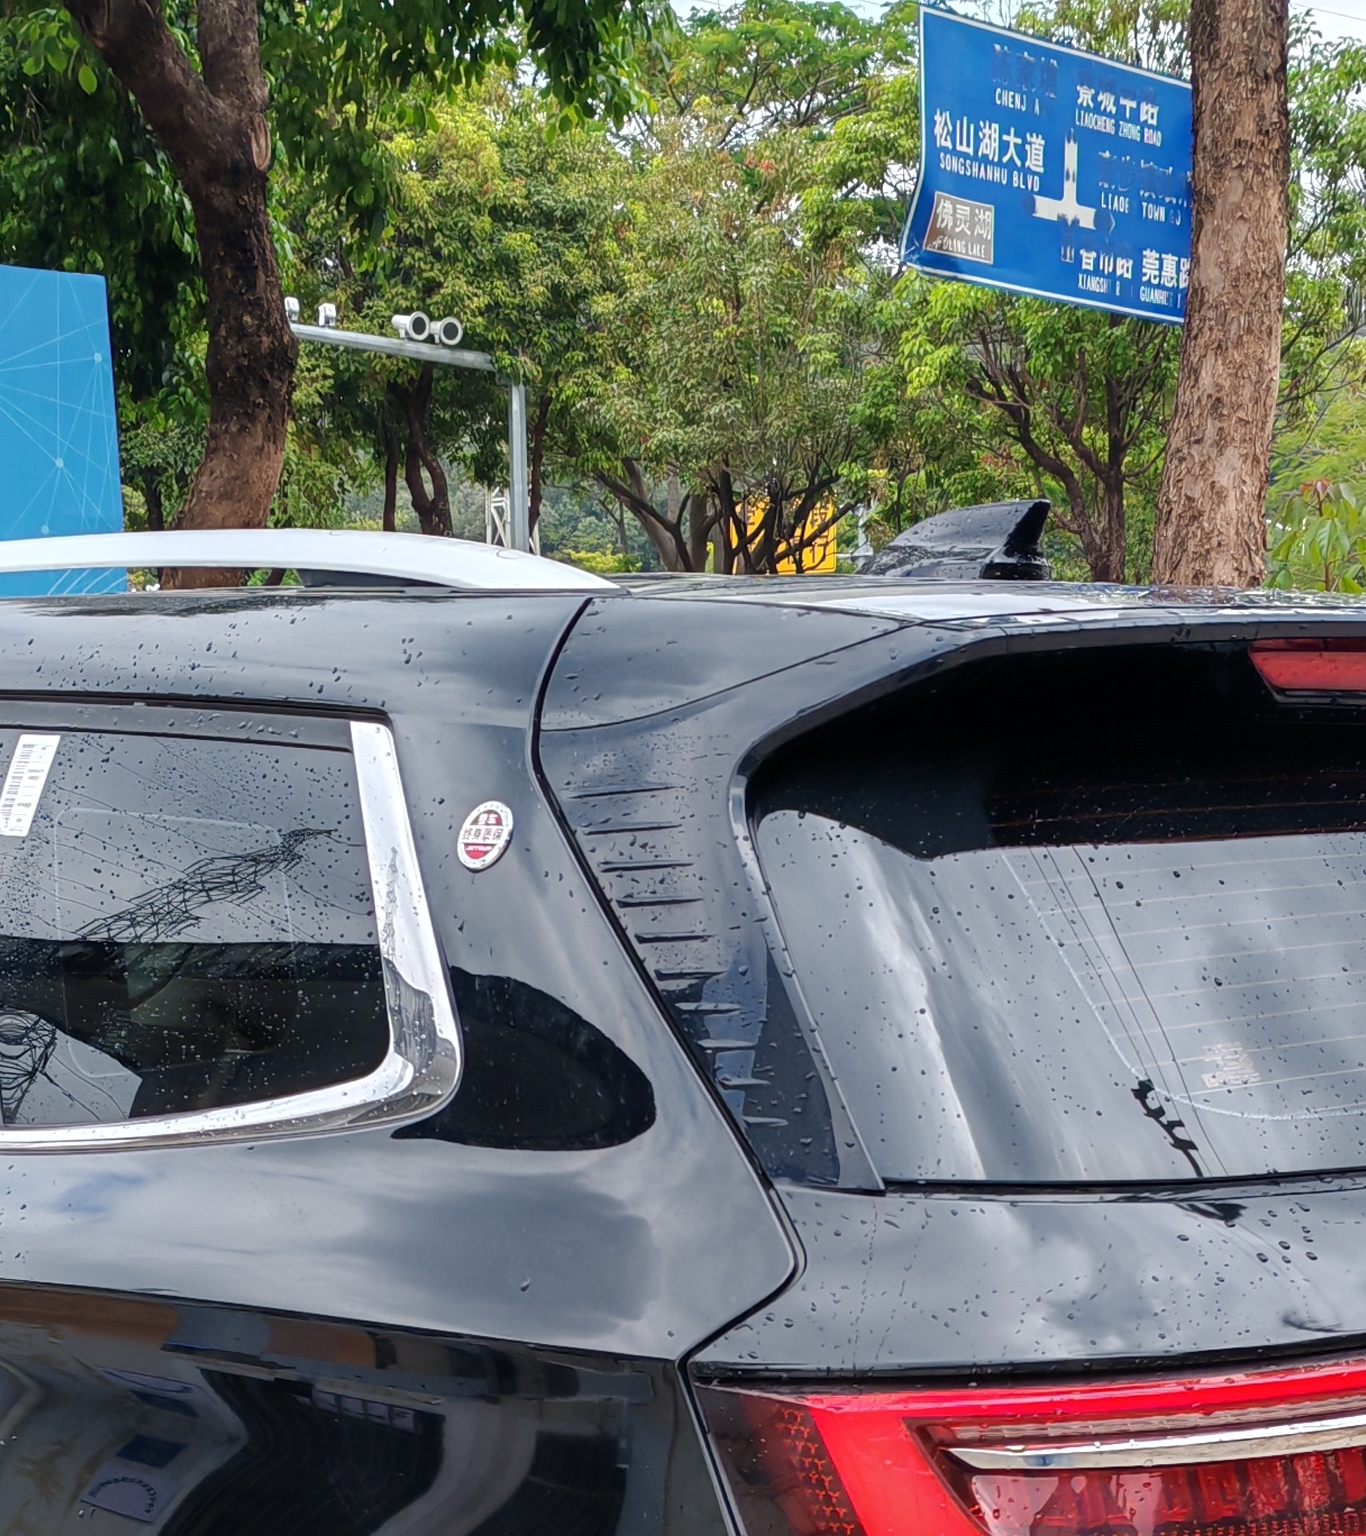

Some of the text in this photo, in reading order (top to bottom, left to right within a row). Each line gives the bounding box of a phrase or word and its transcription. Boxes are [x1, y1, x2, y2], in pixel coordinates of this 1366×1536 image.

[934, 107, 1045, 173] 松山湖大道
[939, 152, 1040, 192] SONGSHANHU BLVD
[937, 199, 992, 240] 佛灵湖
